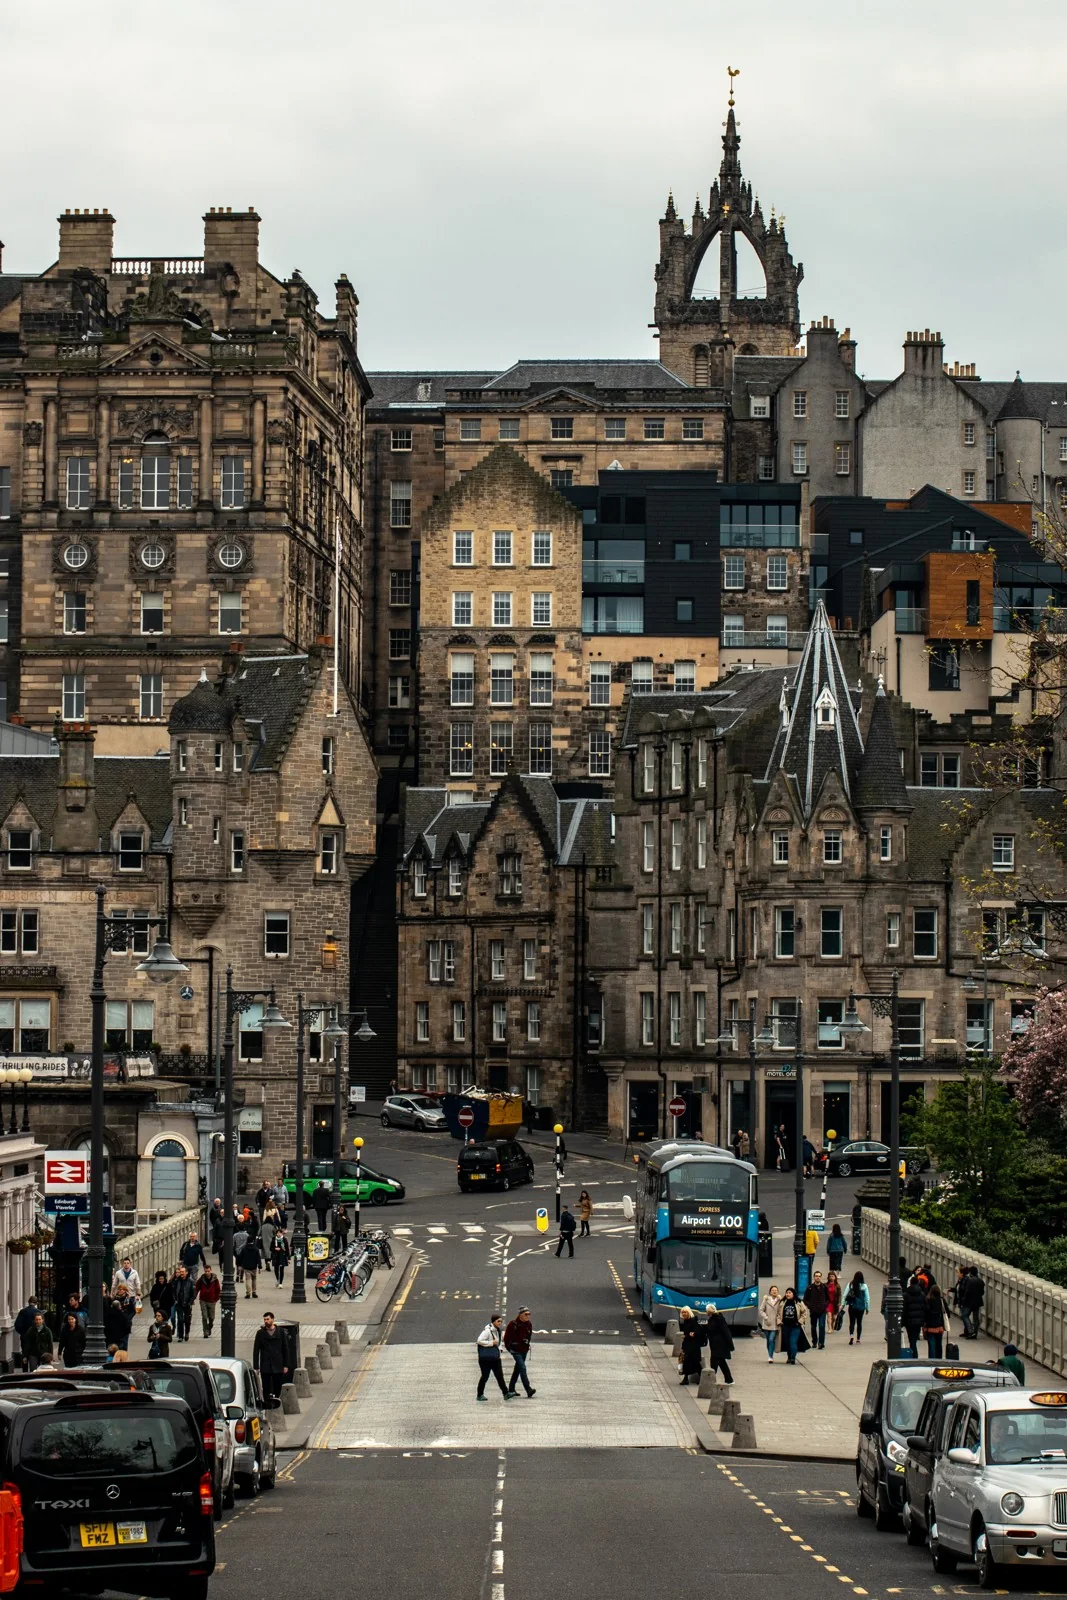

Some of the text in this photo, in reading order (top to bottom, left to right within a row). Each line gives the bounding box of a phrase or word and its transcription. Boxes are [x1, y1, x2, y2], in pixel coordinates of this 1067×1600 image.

[0, 1062, 66, 1071] HRILLING RIDES
[681, 1215, 743, 1228] Airport 100
[945, 1369, 964, 1378] TAXI
[34, 1499, 90, 1510] TAXI
